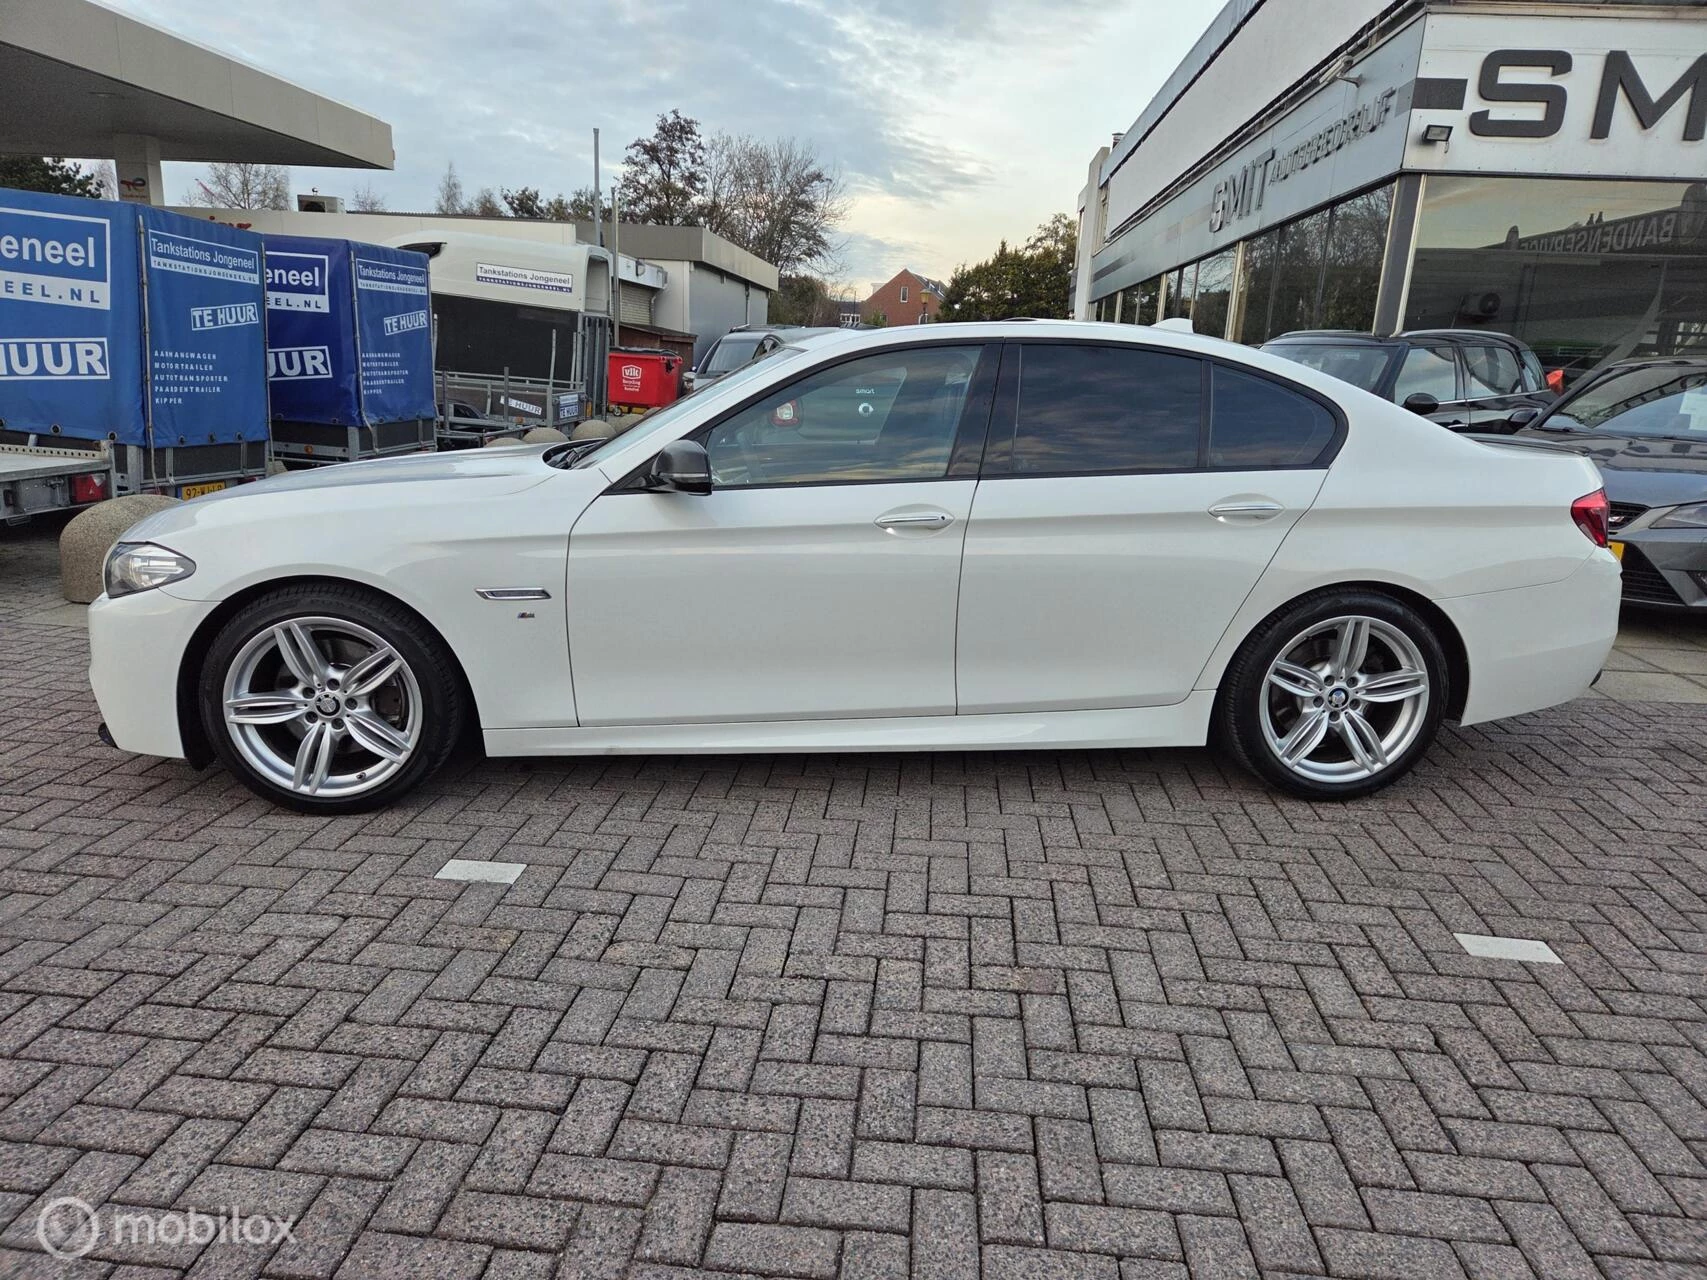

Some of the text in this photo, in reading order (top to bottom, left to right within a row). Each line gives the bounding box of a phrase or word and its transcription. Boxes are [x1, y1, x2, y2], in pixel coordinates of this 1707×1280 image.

[1209, 147, 1276, 233] SMIT
[0, 234, 96, 268] eneel
[151, 238, 255, 269] Tankstations Jongeneel
[359, 264, 425, 284] Tankstations Jongeneel
[479, 266, 571, 285] Tankstations Jongeneel
[5, 280, 100, 303] EEL.NL
[192, 305, 257, 328] TE HUUR
[385, 312, 426, 333] TE HUUR
[154, 362, 213, 371] MOTORTRAILER
[154, 374, 228, 382] AUTOTRANSPORTER
